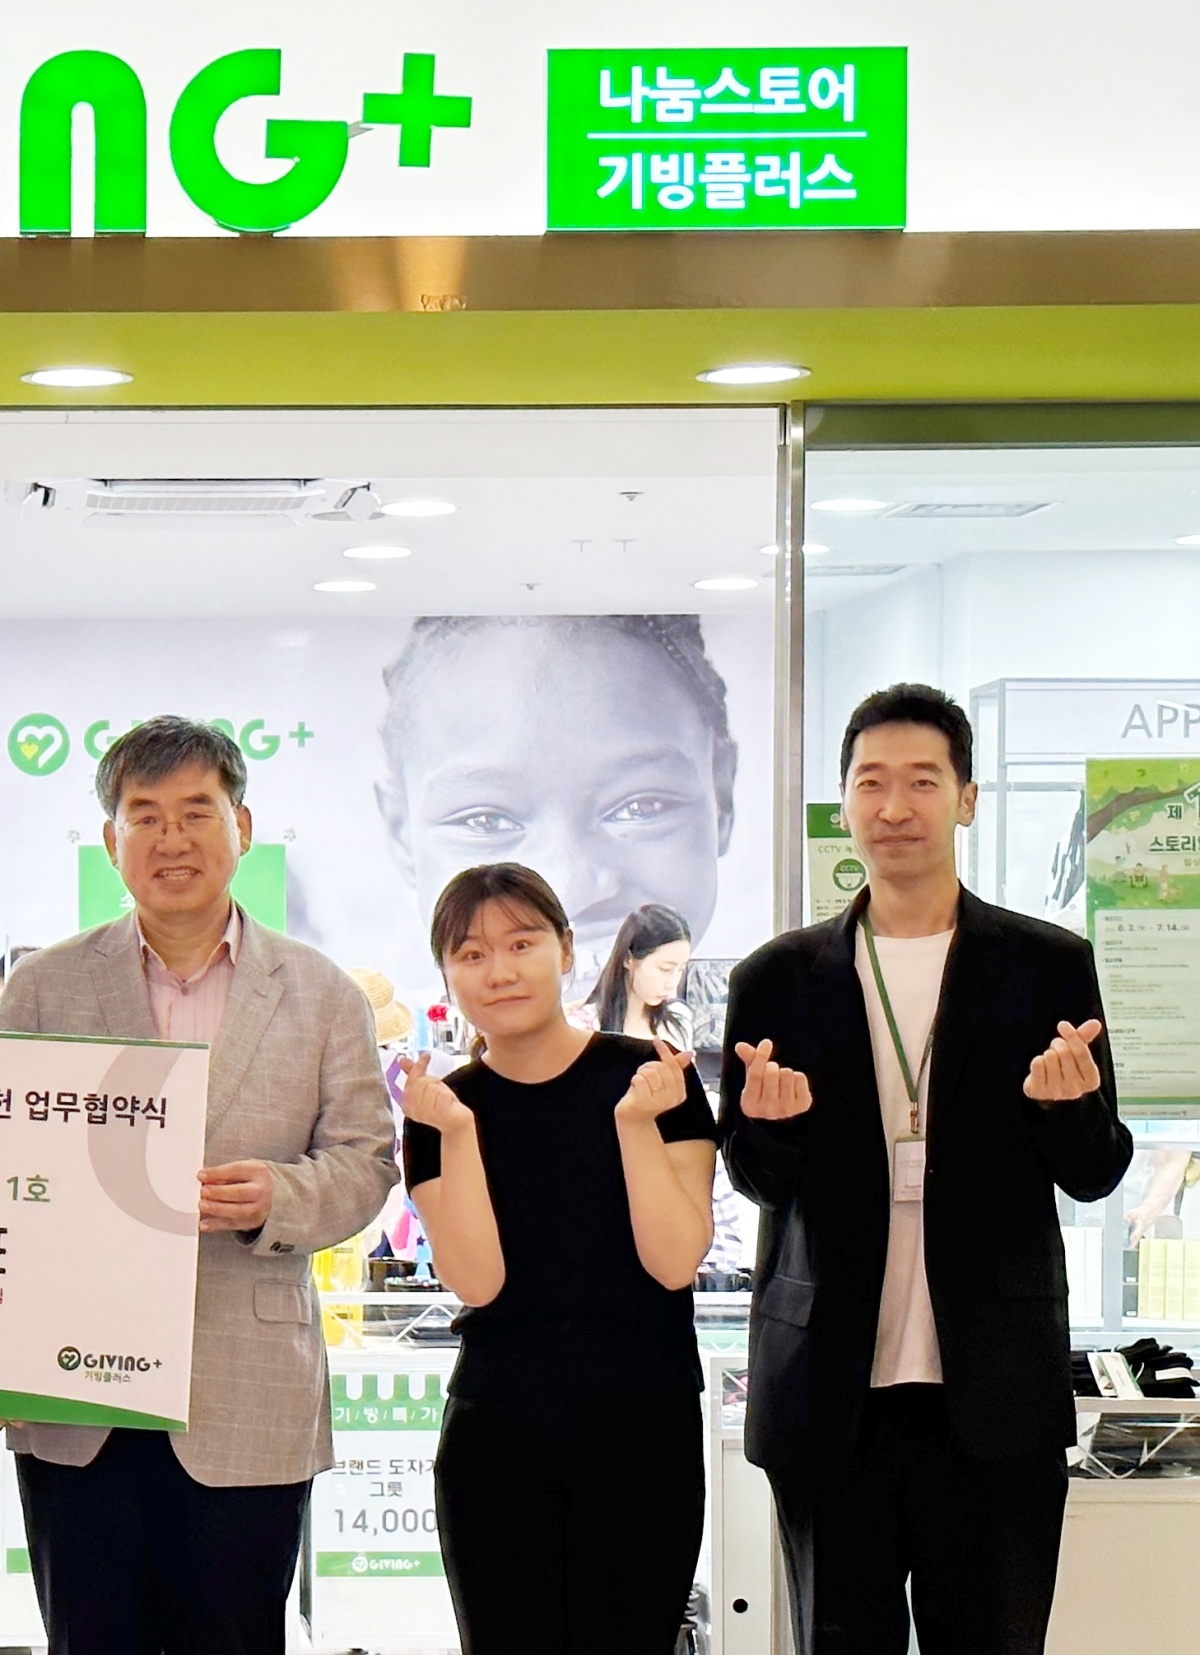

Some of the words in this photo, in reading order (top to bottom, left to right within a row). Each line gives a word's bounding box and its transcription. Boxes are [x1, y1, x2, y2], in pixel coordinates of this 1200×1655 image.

[598, 65, 857, 124] 나눔스토어
[596, 152, 858, 210] 기빙플러스
[1149, 835, 1200, 852] 스토리
[25, 1090, 168, 1129] 업무협약식
[6, 1174, 51, 1203] 1호
[83, 1353, 163, 1373] GIVING+
[84, 1370, 132, 1384] 기빙플러스
[369, 1481, 403, 1498] 그릇
[334, 1508, 438, 1536] 14,000
[369, 1557, 421, 1571] GIVING+
